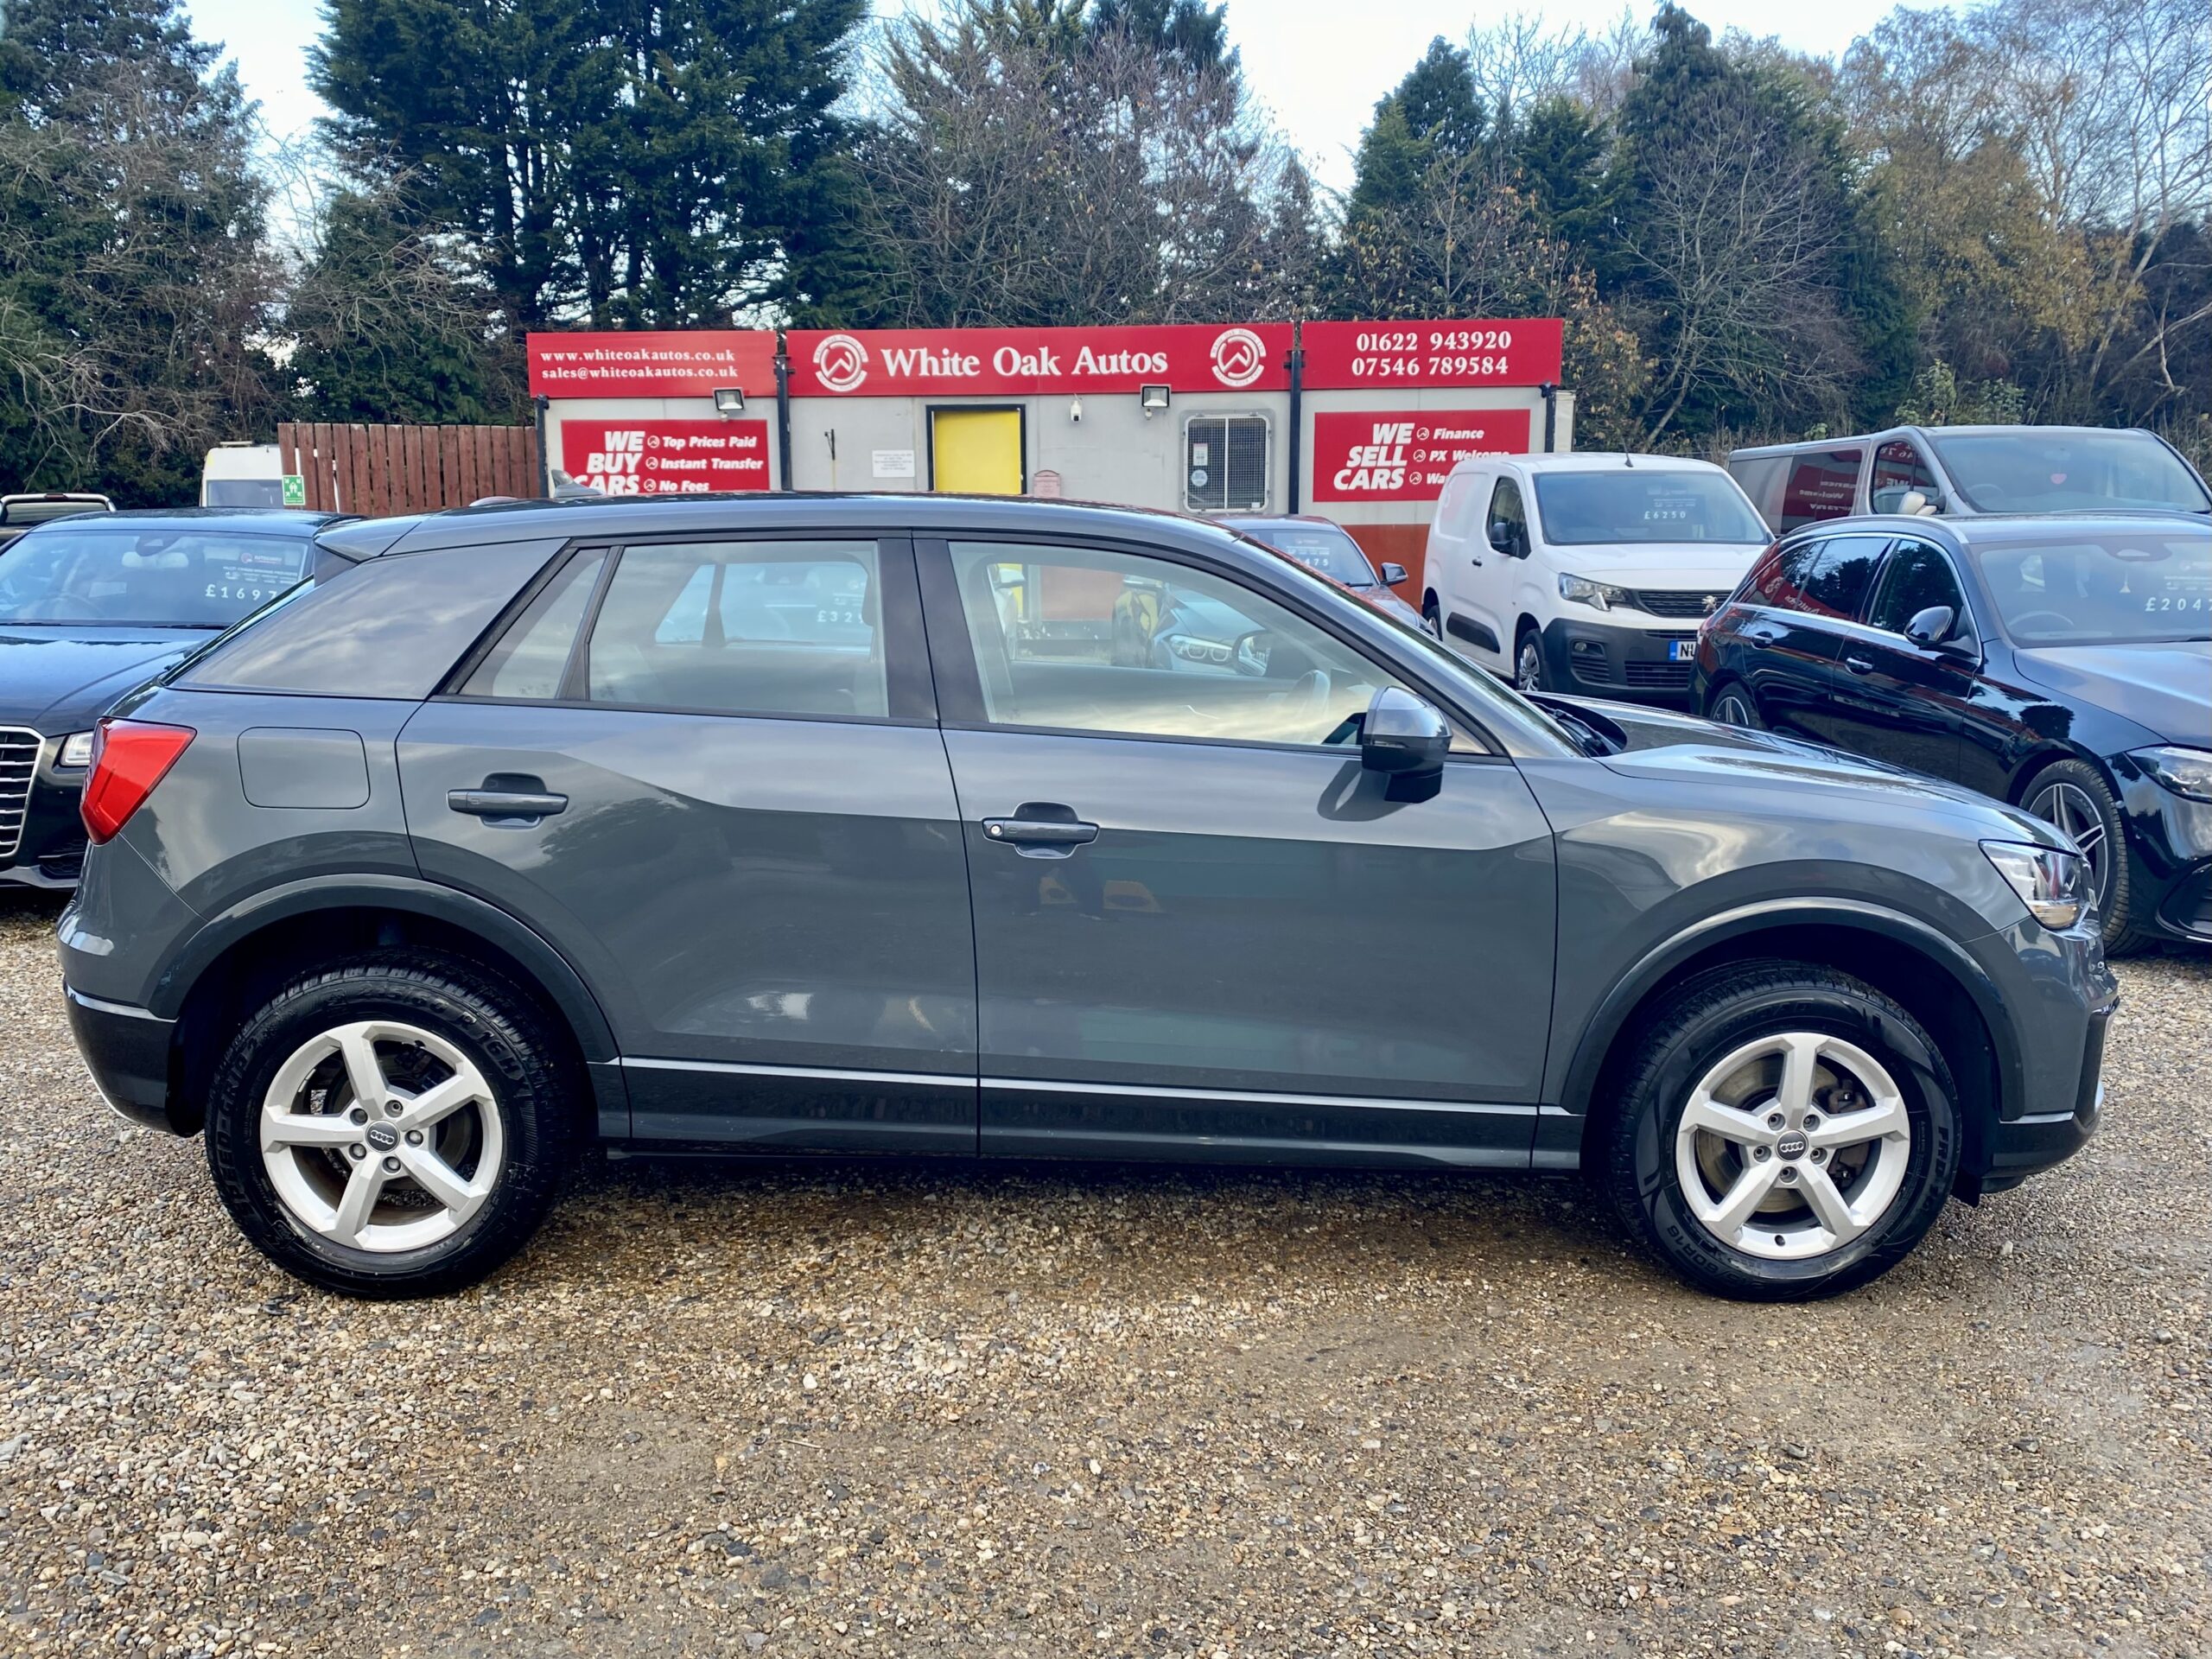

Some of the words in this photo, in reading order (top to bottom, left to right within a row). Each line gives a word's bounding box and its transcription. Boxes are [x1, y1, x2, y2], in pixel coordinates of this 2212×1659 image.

[1356, 332, 1418, 352] 01622
[1430, 331, 1512, 351] 943920
[540, 348, 735, 362] www.whiteoakautos.co.uk
[880, 346, 982, 377] White
[993, 346, 1062, 377] Oak
[1071, 346, 1168, 375] Autos
[542, 365, 739, 379] sales@whiteoakautos.co.uk
[1351, 357, 1420, 376] 07546
[1428, 356, 1509, 375] 789584
[604, 430, 645, 451] WE
[662, 435, 686, 450] Top
[689, 435, 726, 448] Prices
[728, 435, 757, 448] Paid
[1372, 423, 1415, 445] WE
[1433, 428, 1484, 440] Finance
[587, 453, 643, 474] BUY
[660, 458, 708, 469] Instant
[711, 457, 764, 469] Transfer
[1346, 446, 1408, 467] SELL
[1428, 450, 1448, 462] PX
[659, 480, 678, 492] No
[681, 480, 710, 492] Fees
[1333, 468, 1406, 490] CARS
[1643, 511, 1687, 519] £6250
